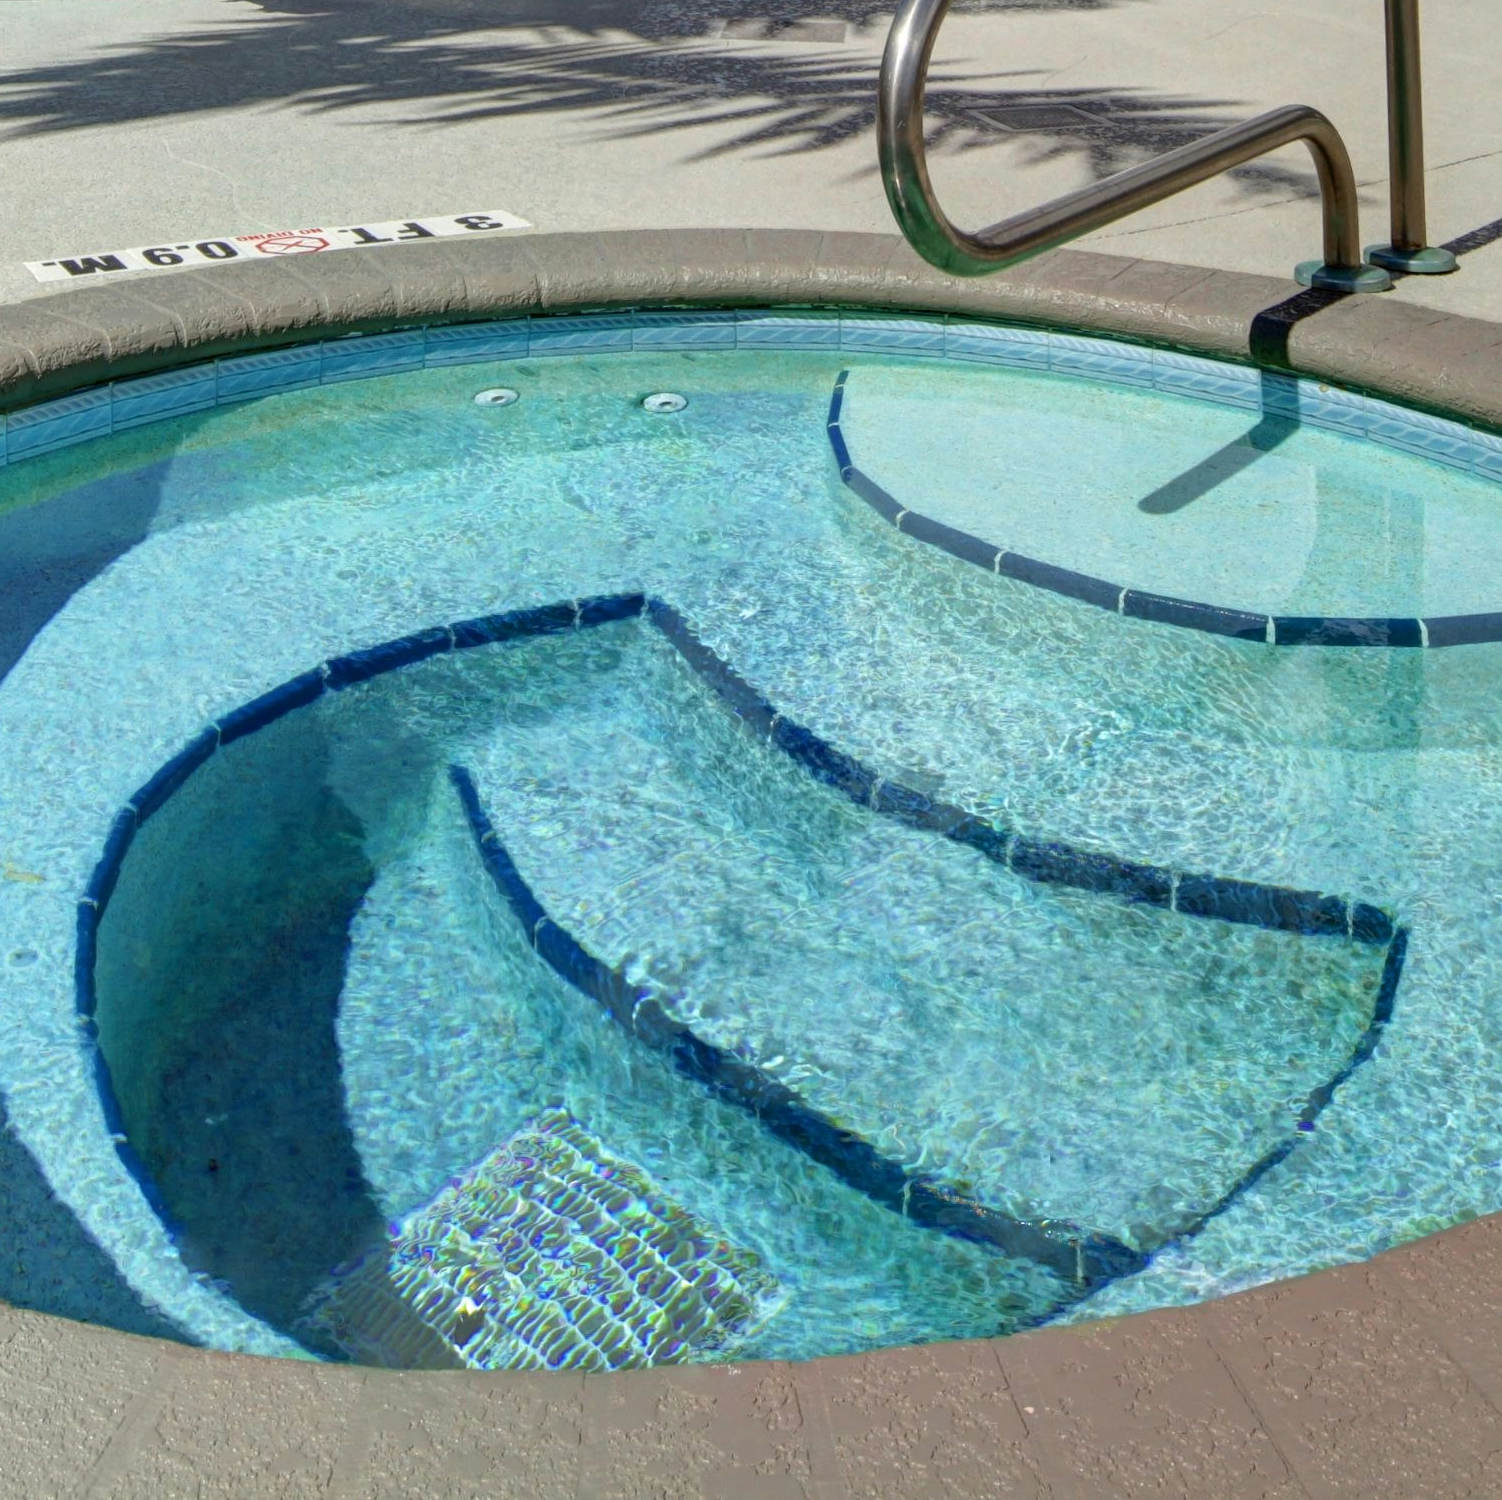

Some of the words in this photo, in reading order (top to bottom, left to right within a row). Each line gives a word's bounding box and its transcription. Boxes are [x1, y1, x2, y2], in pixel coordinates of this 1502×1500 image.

[299, 227, 323, 235] NO
[454, 215, 504, 231] 3
[236, 230, 293, 242] DIVING
[337, 222, 437, 245] FT.
[142, 241, 239, 266] 0.9
[41, 255, 128, 276] M.
